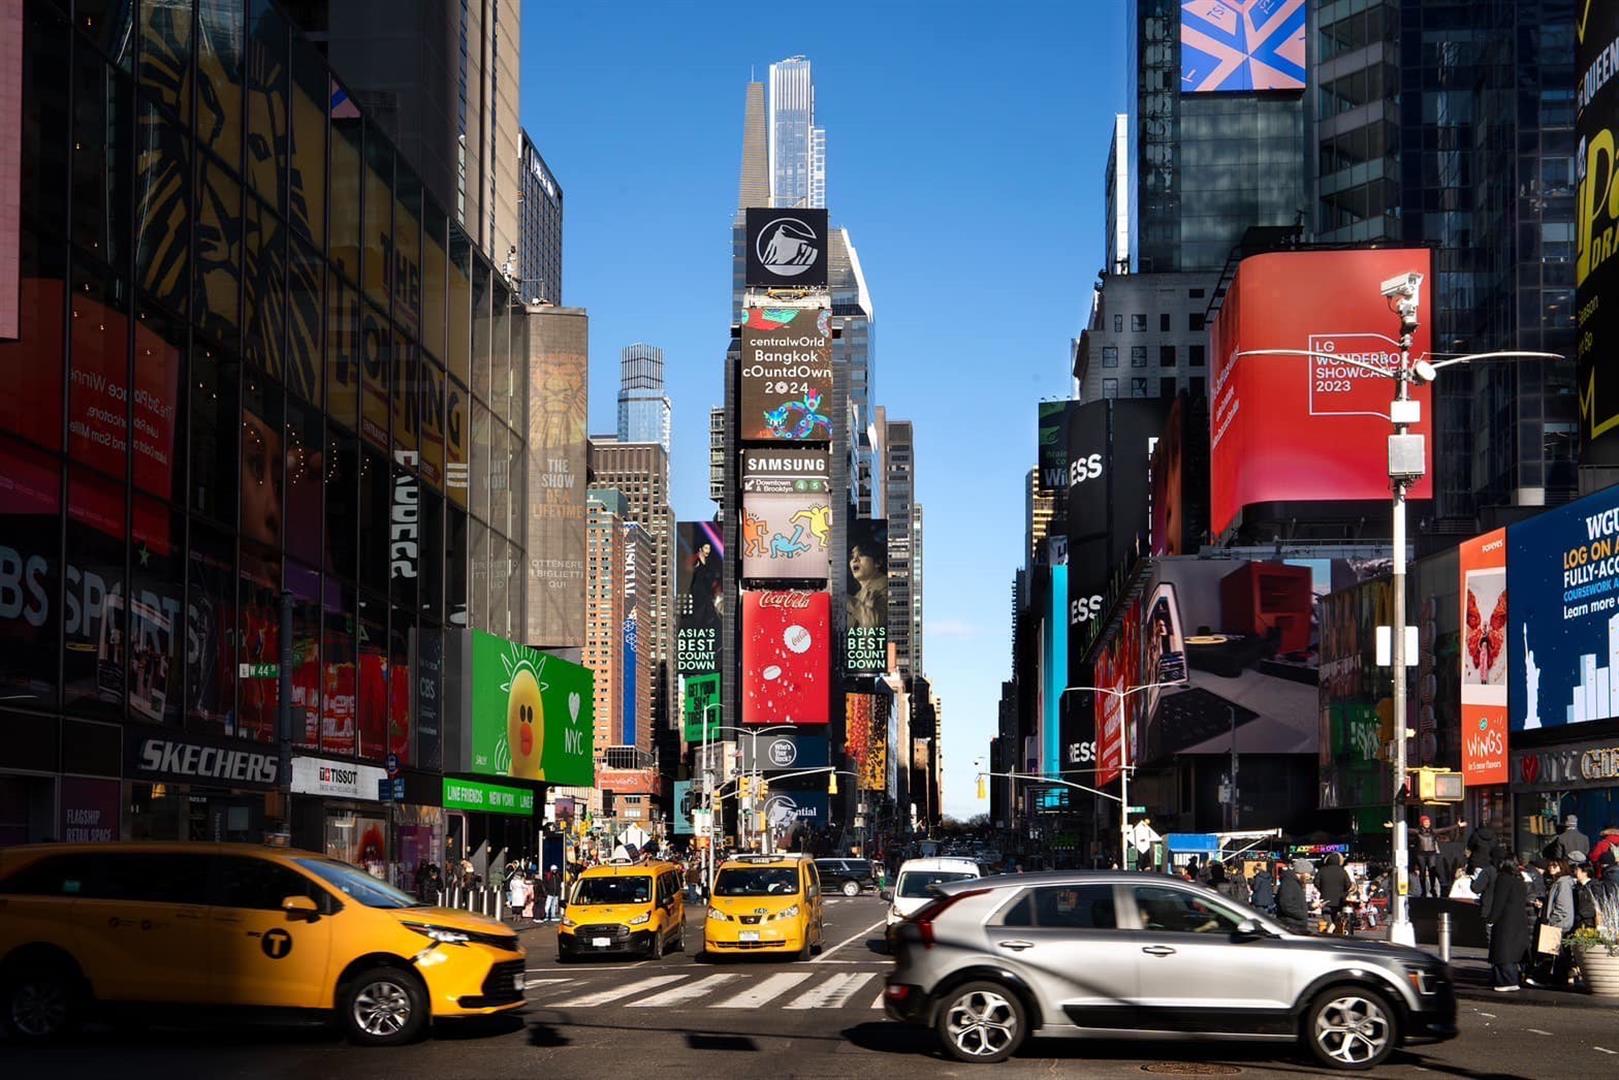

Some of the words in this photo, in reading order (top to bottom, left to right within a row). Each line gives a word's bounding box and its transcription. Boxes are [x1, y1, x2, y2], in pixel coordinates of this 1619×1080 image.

[1316, 341, 1335, 352] LG
[755, 350, 818, 365] Bangkok
[1316, 381, 1351, 392] 2023
[547, 459, 569, 473] THE
[748, 458, 825, 471] SAMSUNG
[541, 474, 575, 489] SHOW
[764, 485, 793, 493] Brooklyn
[1564, 546, 1587, 570] LOG
[1591, 539, 1610, 560] ON
[760, 591, 810, 608] Coca-Cola
[1564, 604, 1588, 619] Learn
[1590, 597, 1615, 610] more
[678, 628, 716, 638] ASIA'S
[848, 627, 886, 636] ASIA'S
[678, 639, 716, 651] BEST
[848, 638, 886, 650] BEST
[678, 651, 716, 660] COUNT
[848, 650, 886, 659] COUNT
[258, 665, 269, 676] 44
[678, 660, 715, 670] DOWN
[848, 660, 885, 669] DOWN
[564, 727, 584, 756] NYC
[137, 739, 280, 783] SKECHERS
[331, 768, 357, 785] TISSOT
[447, 785, 460, 801] LINE
[461, 787, 483, 804] FRIENDS
[489, 791, 500, 805] NEW
[66, 809, 101, 825] FLAGSHIP
[269, 933, 287, 955] T
